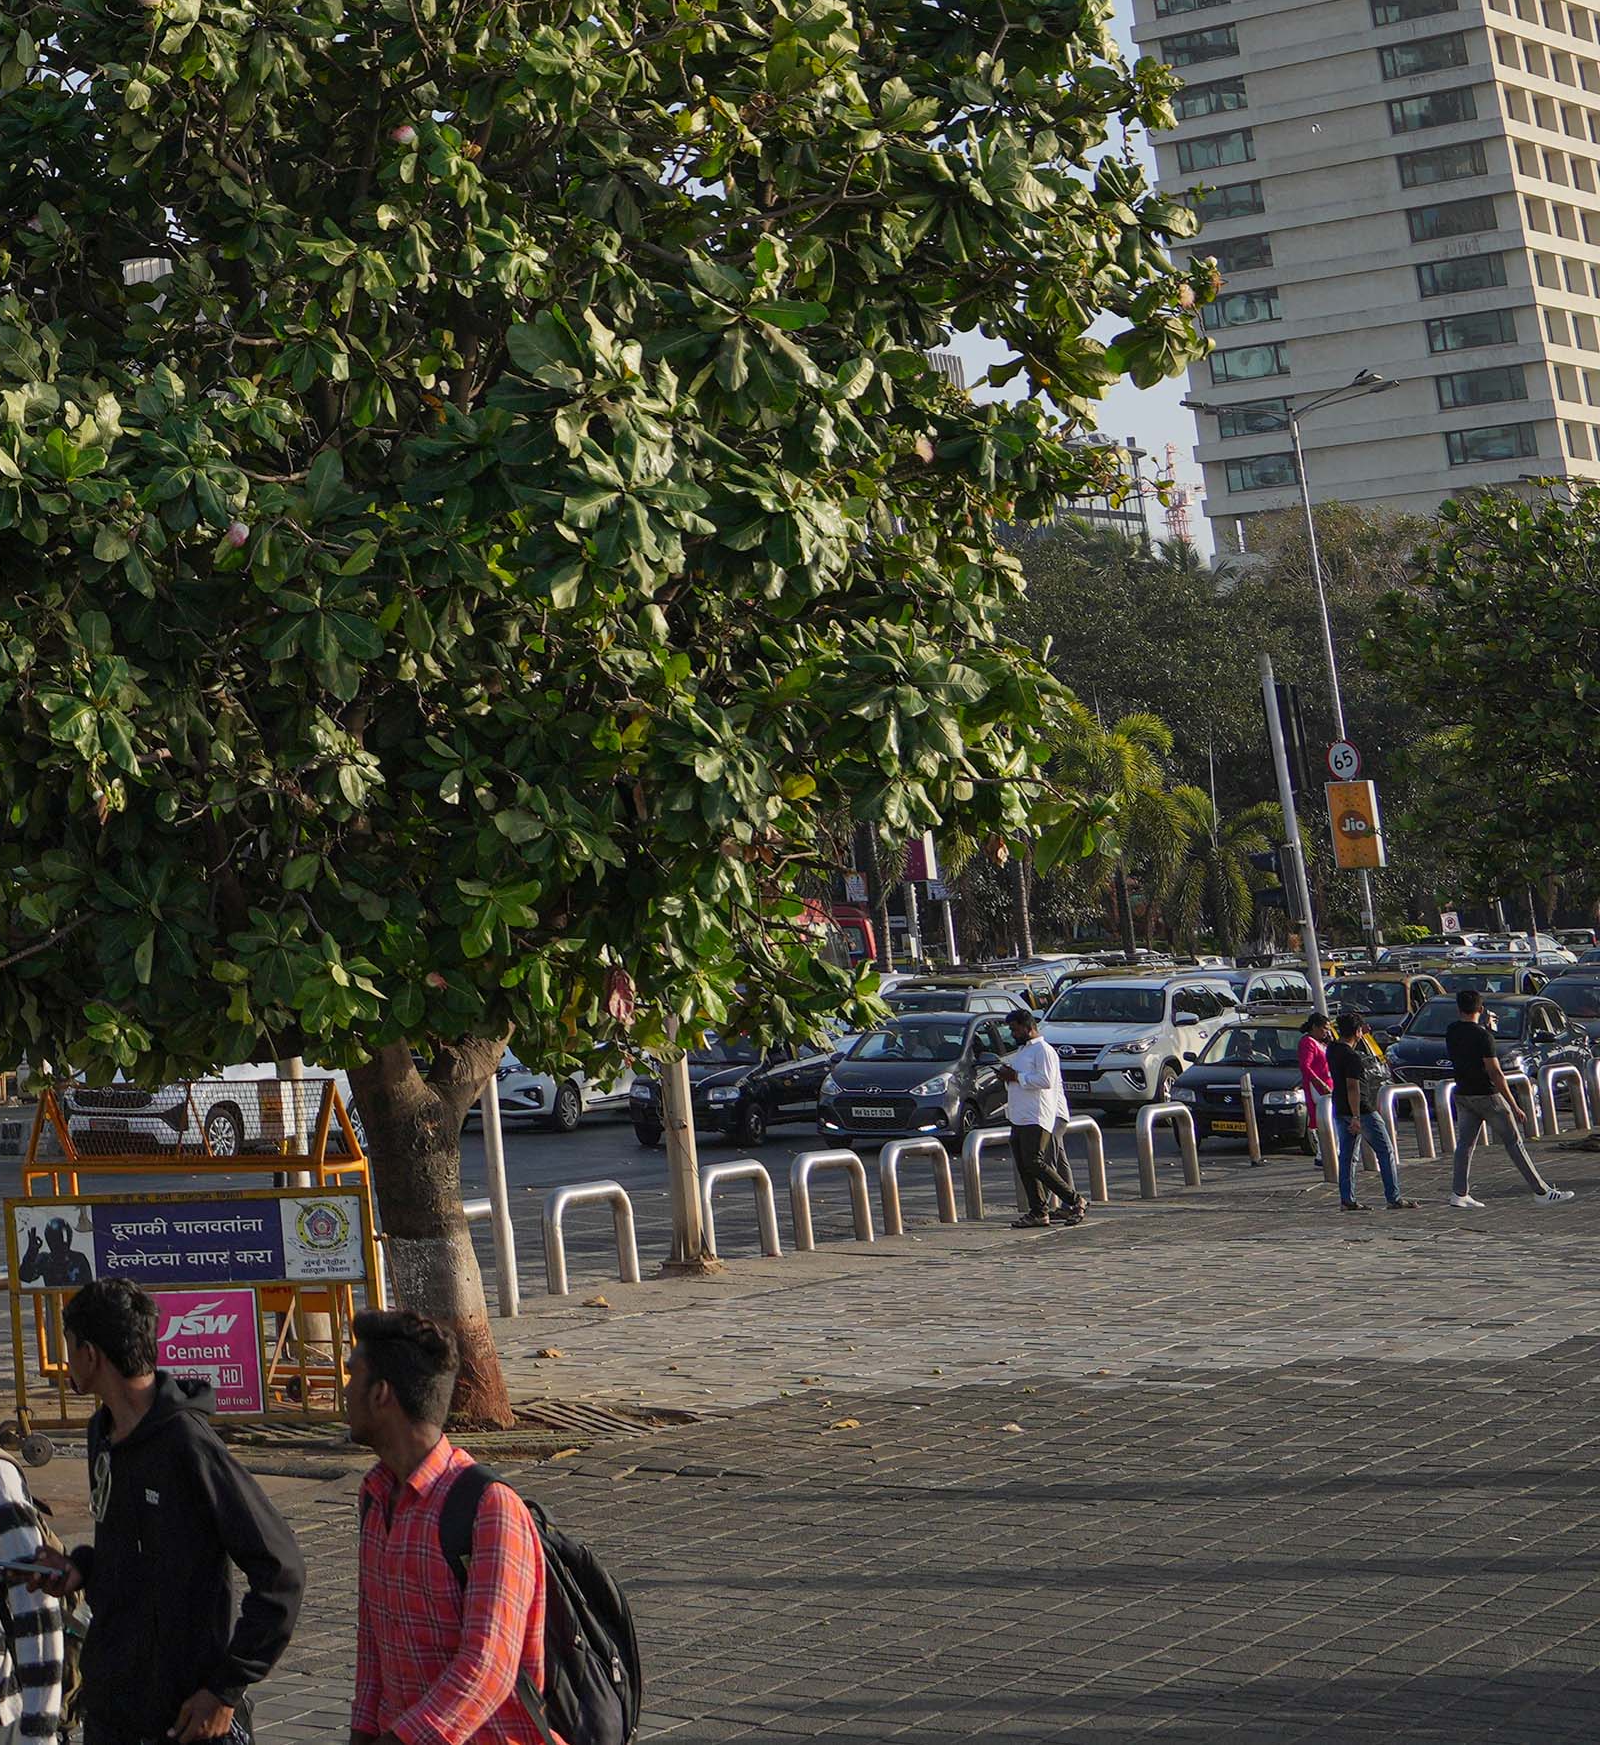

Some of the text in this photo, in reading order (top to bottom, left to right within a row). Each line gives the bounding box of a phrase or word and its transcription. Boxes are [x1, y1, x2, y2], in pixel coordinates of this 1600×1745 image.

[1334, 750, 1353, 770] 65
[1341, 817, 1366, 831] Jio
[111, 1216, 263, 1241] दूचाकी चालवतांना
[106, 1248, 273, 1269] हेल्मेटचा वापर करा
[157, 1314, 238, 1342] JSW
[166, 1344, 231, 1360] Cement
[222, 1369, 239, 1384] HD
[233, 1397, 253, 1406] free)
